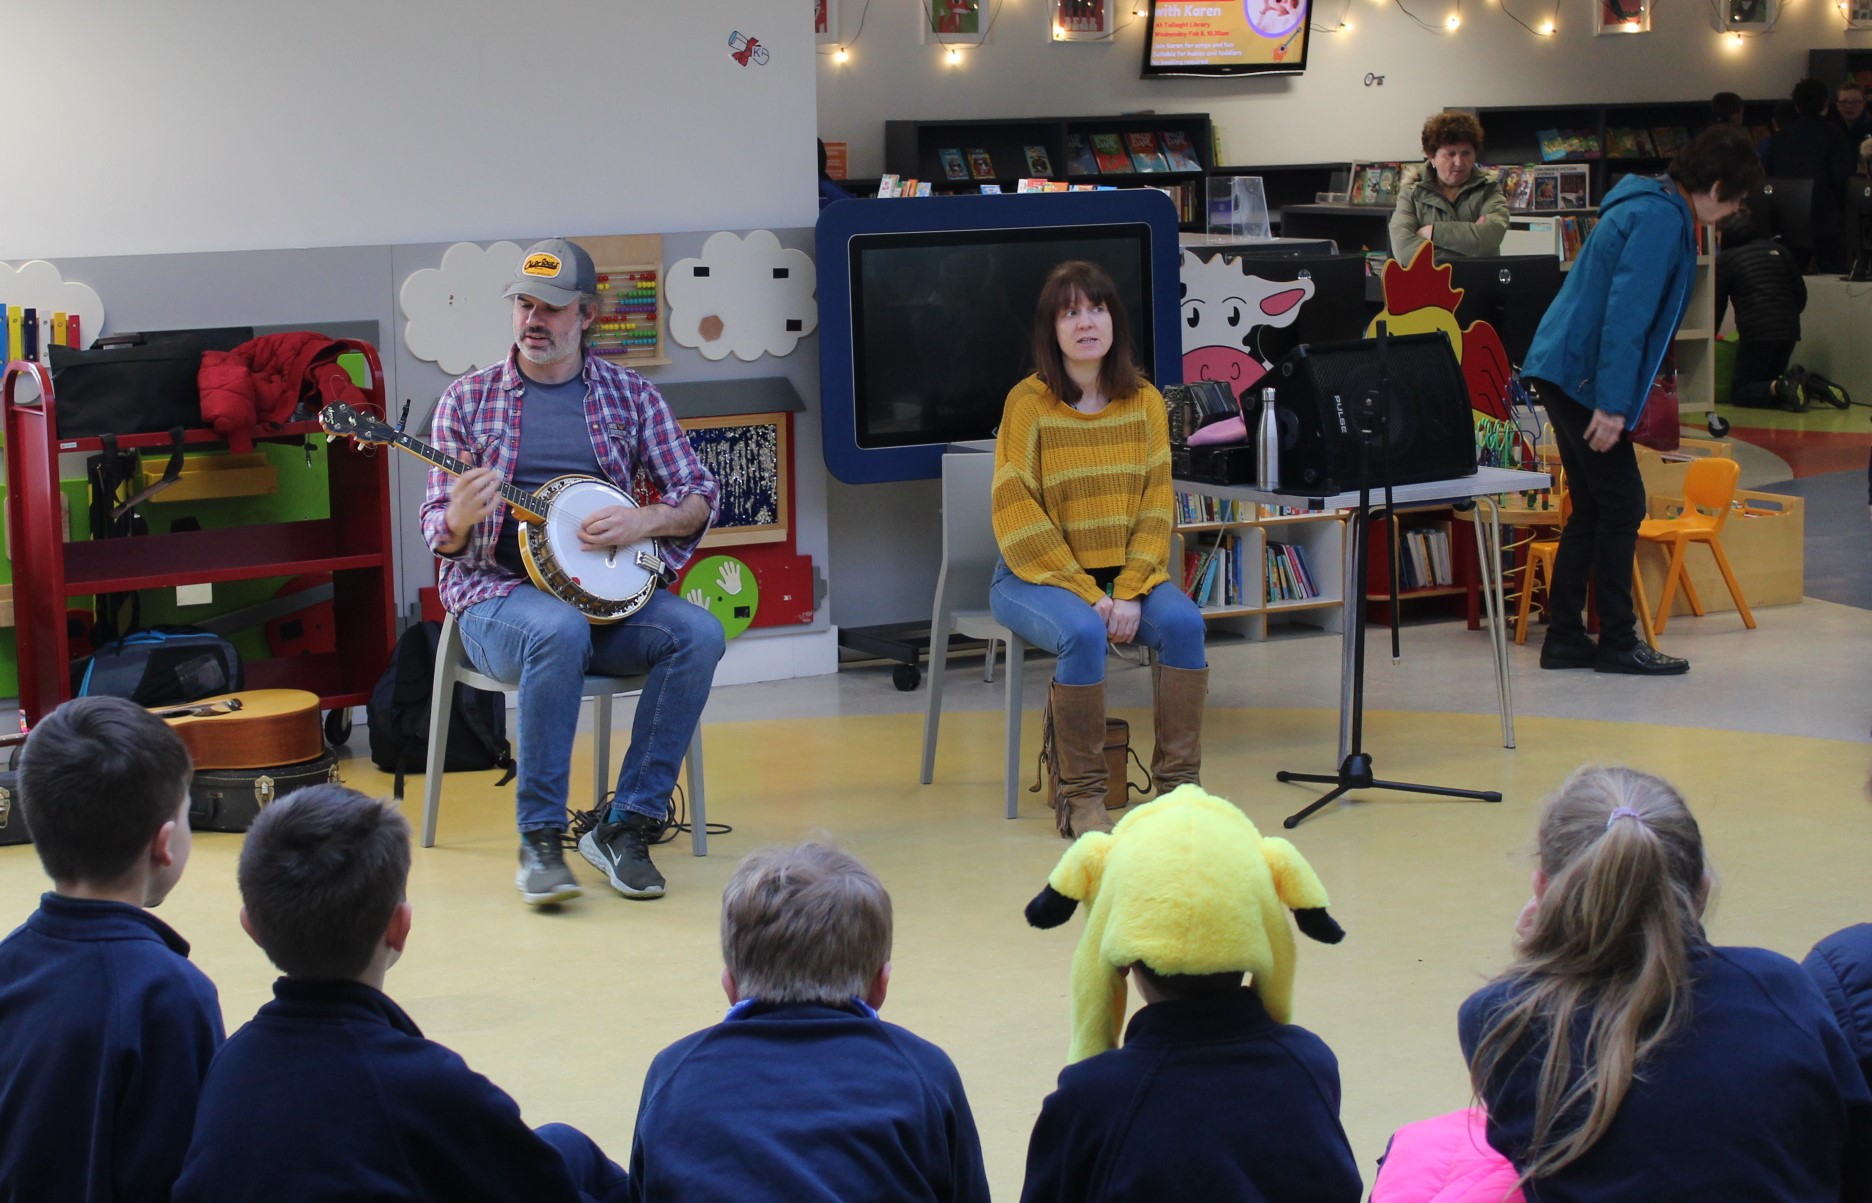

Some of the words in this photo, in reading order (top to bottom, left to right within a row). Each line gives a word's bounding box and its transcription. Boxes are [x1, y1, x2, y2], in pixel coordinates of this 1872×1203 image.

[1155, 4, 1180, 17] with
[1183, 4, 1221, 17] Karen
[1190, 21, 1210, 29] Library
[1334, 395, 1347, 434] PULSE
